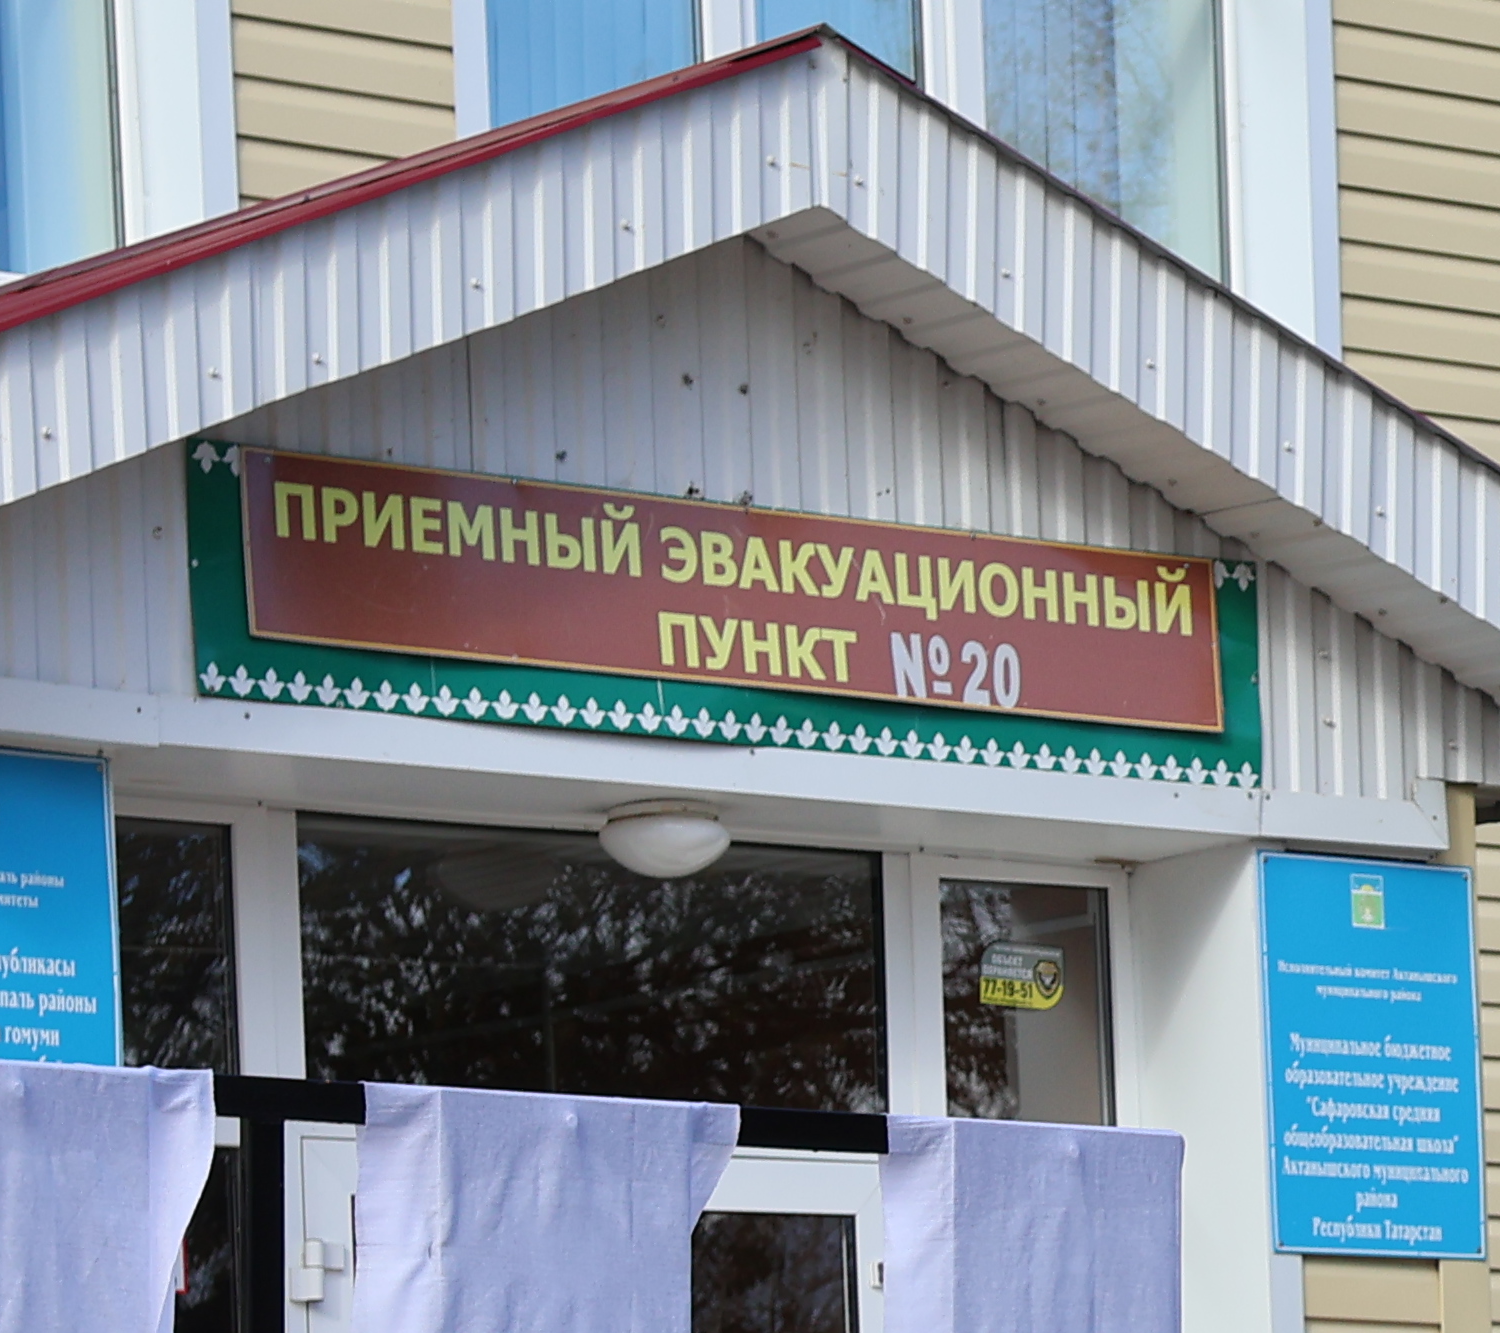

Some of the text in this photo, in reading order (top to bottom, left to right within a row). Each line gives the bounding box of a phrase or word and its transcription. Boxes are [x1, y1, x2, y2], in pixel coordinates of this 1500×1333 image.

[274, 482, 1193, 636] ПРИЕМНЫЙ ЭВАКУАЦИОННЫЙ
[658, 612, 1021, 708] ПУНКТ № 20
[20, 871, 64, 888] районы
[39, 989, 97, 1017] районы
[4, 1026, 60, 1051] гомуми
[1289, 1032, 1452, 1062] Муниципальное бюджетное
[1284, 1060, 1459, 1096] образовательное учреждение
[1392, 1105, 1441, 1126] средняя
[1284, 1123, 1414, 1154] общеобразовательная
[1283, 1155, 1469, 1185] Актанышского муниципального
[1355, 1186, 1398, 1213] района
[1383, 1219, 1443, 1246] Татарстан
